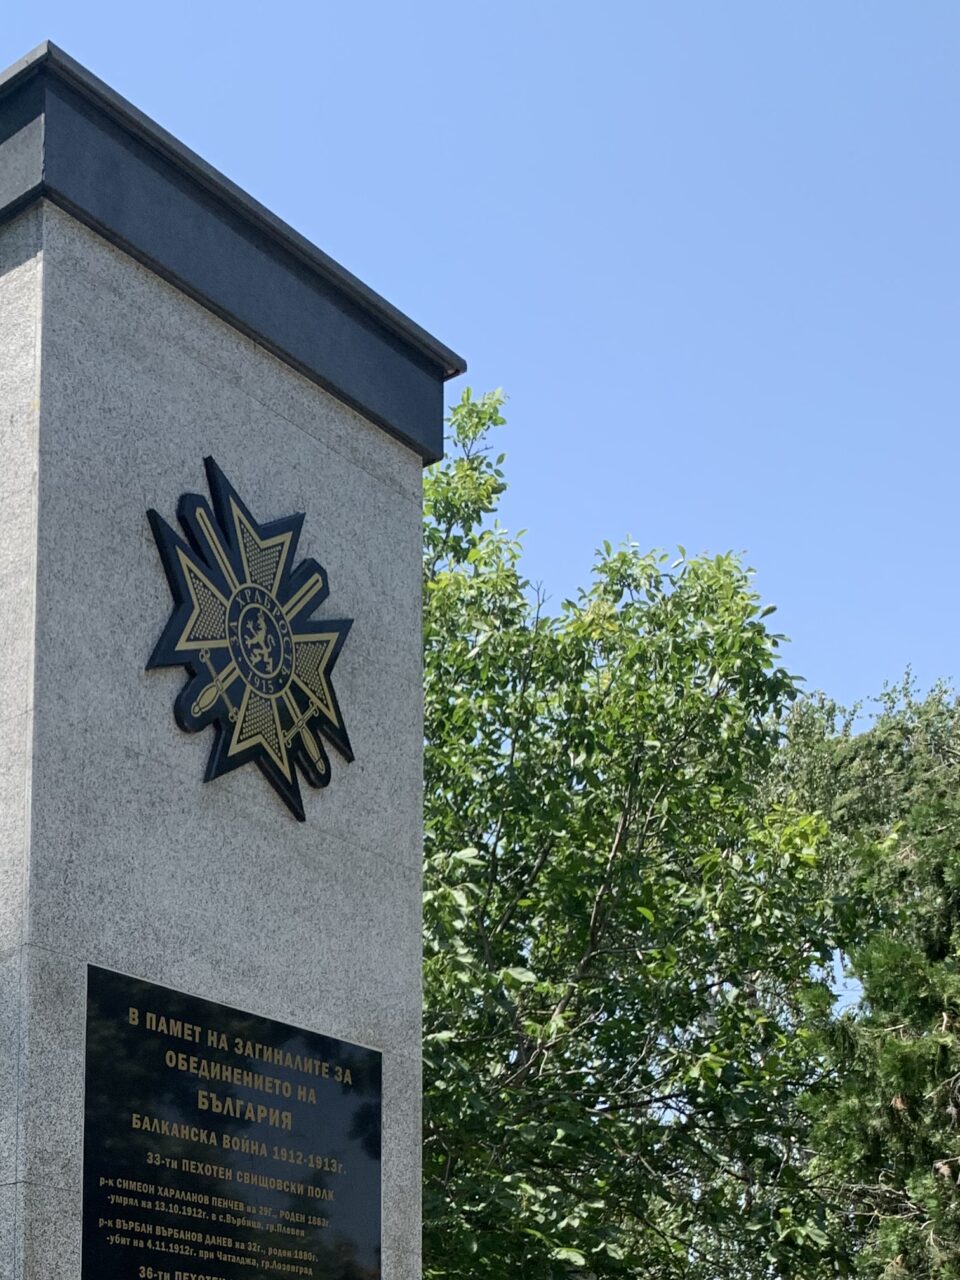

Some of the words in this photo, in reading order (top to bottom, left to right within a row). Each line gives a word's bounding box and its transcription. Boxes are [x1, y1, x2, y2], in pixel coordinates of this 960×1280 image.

[247, 670, 274, 694] 1915
[128, 1006, 139, 1025] В
[146, 1011, 200, 1042] ПАМЕТ
[207, 1029, 227, 1050] НА
[234, 1036, 328, 1078] ЗАГИНАЛИТЕ
[334, 1065, 352, 1085] ЗА
[165, 1049, 291, 1099] ОБЕДИНЕНИЕТО
[297, 1085, 315, 1103] НА
[197, 1090, 291, 1130] БЪЛГАРИЯ
[131, 1113, 216, 1145] БАЛКАНСКА
[222, 1131, 267, 1157] ВОЙНА
[273, 1145, 346, 1174] 1912-1913г.
[116, 1177, 154, 1194] СИМЕОН
[211, 1196, 244, 1211] ПЕНЧЕВ
[146, 1151, 177, 1169] 33-ти
[181, 1159, 232, 1180] ПЕХОТЕН
[236, 1170, 303, 1196] СВИЩОВСКИ
[307, 1186, 334, 1201] ПОЛК
[115, 1218, 152, 1233] ВЪРБАН
[155, 1225, 202, 1242] ВЪРБАНОВ
[204, 1233, 232, 1248] ДАНЕВ
[138, 1265, 170, 1280] 36-ти
